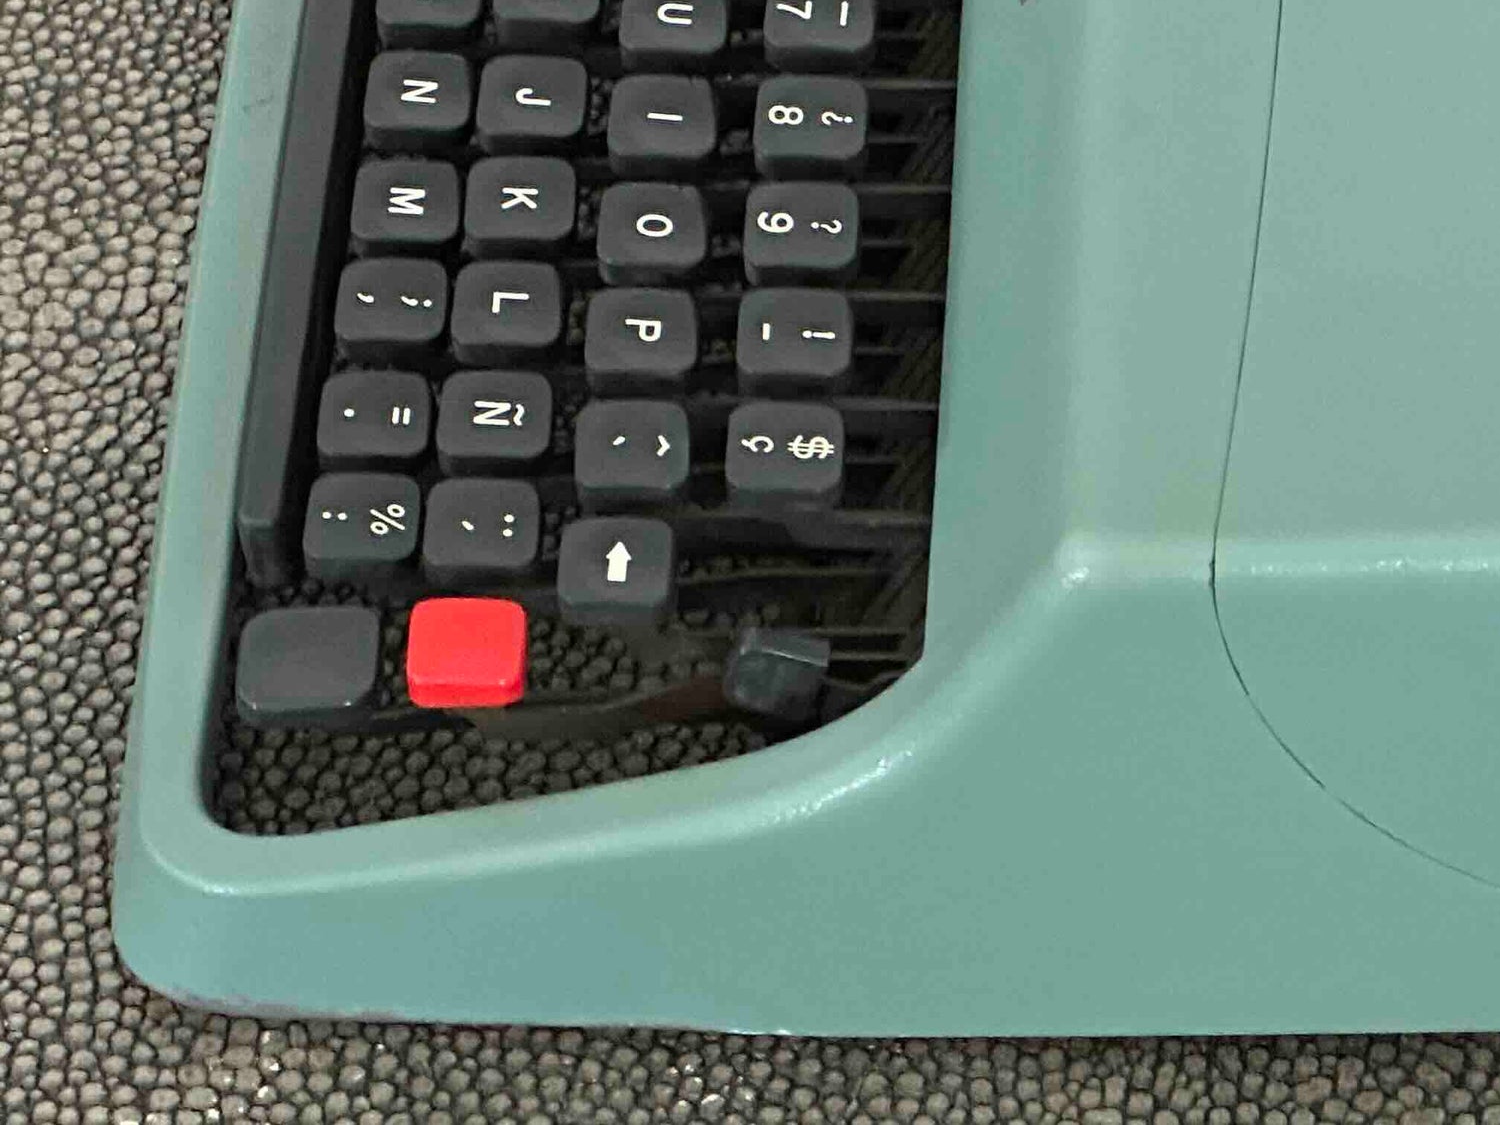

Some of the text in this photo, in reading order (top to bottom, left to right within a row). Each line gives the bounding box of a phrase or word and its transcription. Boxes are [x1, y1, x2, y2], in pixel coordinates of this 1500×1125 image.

[657, 3, 694, 25] U
[776, 0, 813, 20] 7
[400, 79, 439, 104] N
[515, 87, 552, 106] J
[647, 112, 683, 122] I
[768, 105, 804, 126] 8
[821, 111, 853, 126] ¿
[387, 187, 426, 215] M
[501, 187, 539, 209] K
[636, 213, 674, 238] O
[757, 211, 794, 234] 9
[810, 219, 843, 234] ?
[400, 295, 433, 308] ;
[491, 291, 529, 314] L
[624, 318, 662, 342] P
[802, 330, 836, 340] !
[391, 406, 411, 425] =
[472, 400, 525, 426] Ñ
[741, 435, 775, 453] ç
[787, 434, 835, 459] $
[322, 511, 348, 521] :
[369, 503, 406, 536] %
